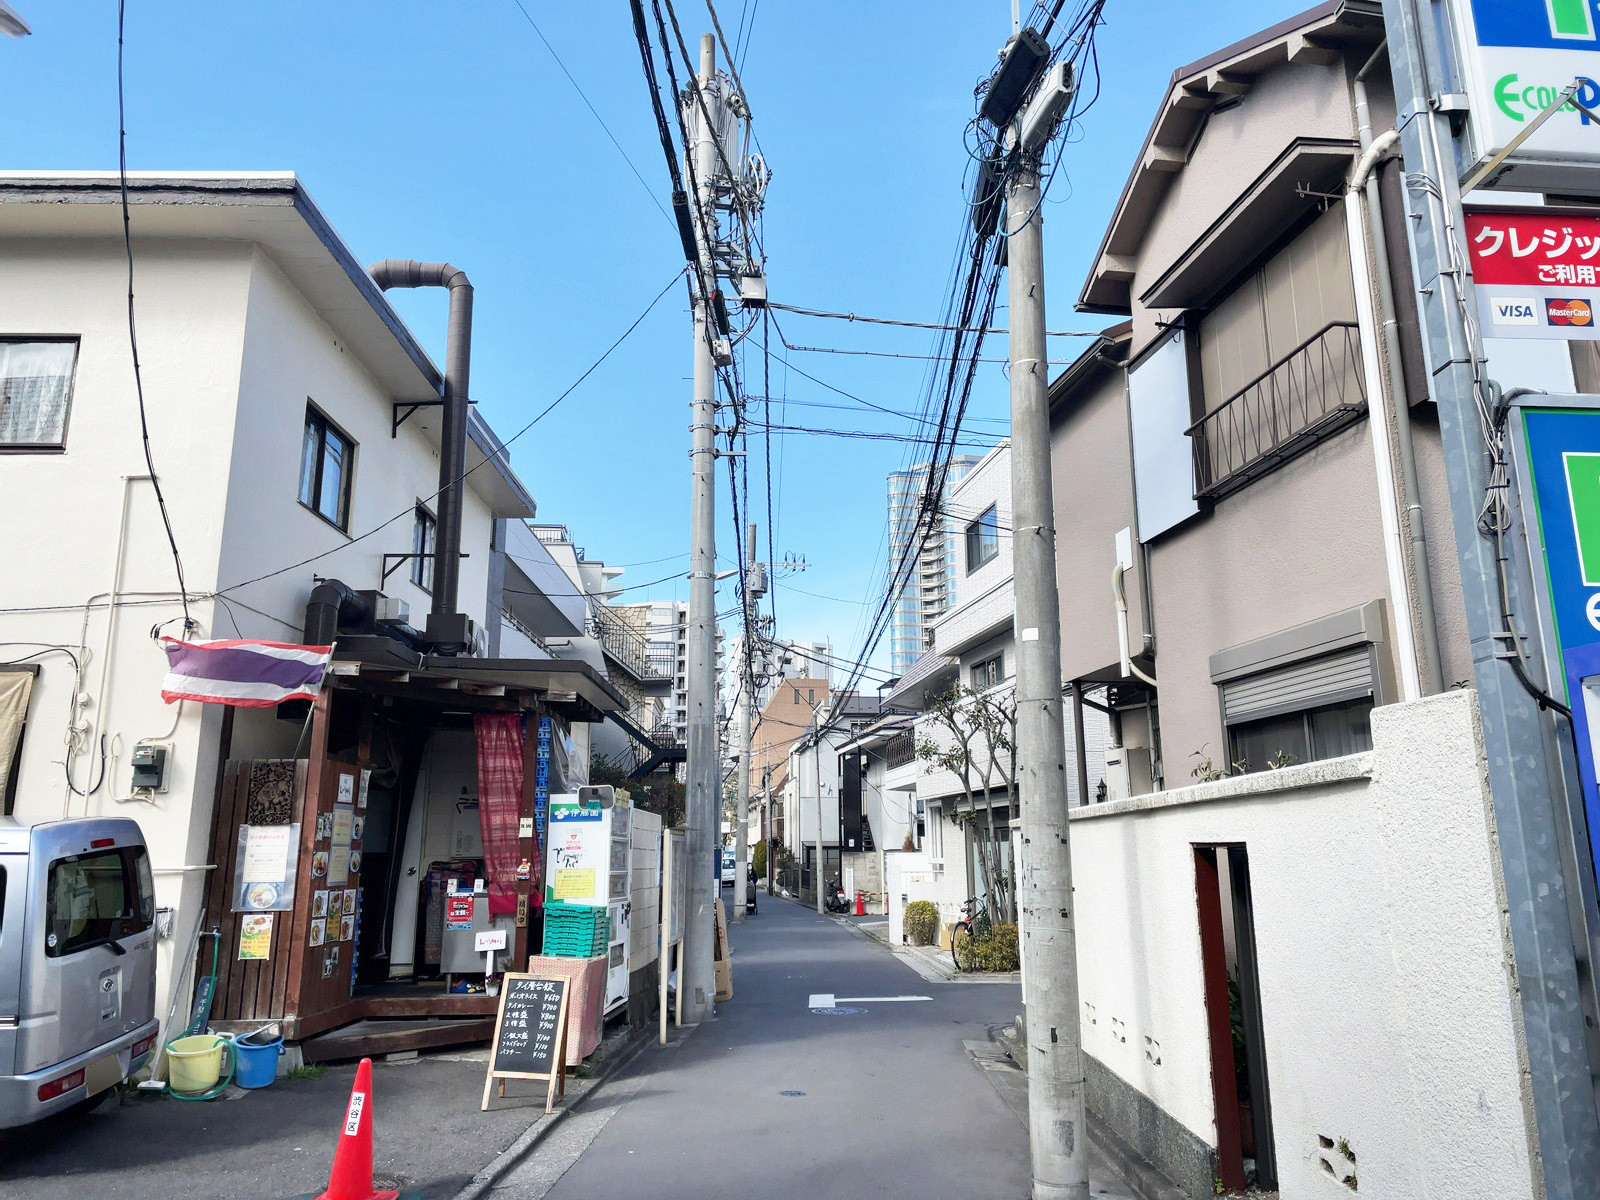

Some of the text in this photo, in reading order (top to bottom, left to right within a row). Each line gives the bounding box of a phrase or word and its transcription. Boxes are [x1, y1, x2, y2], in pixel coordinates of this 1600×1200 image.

[1538, 264, 1600, 284] ご利用
[1497, 305, 1533, 318] VISA
[1549, 308, 1590, 318] MasterCard
[543, 993, 561, 1002] ¥650
[542, 1003, 558, 1011] ¥700
[540, 1012, 556, 1020] ¥800
[538, 1021, 554, 1030] ¥900
[347, 1096, 363, 1132] 渋谷区
